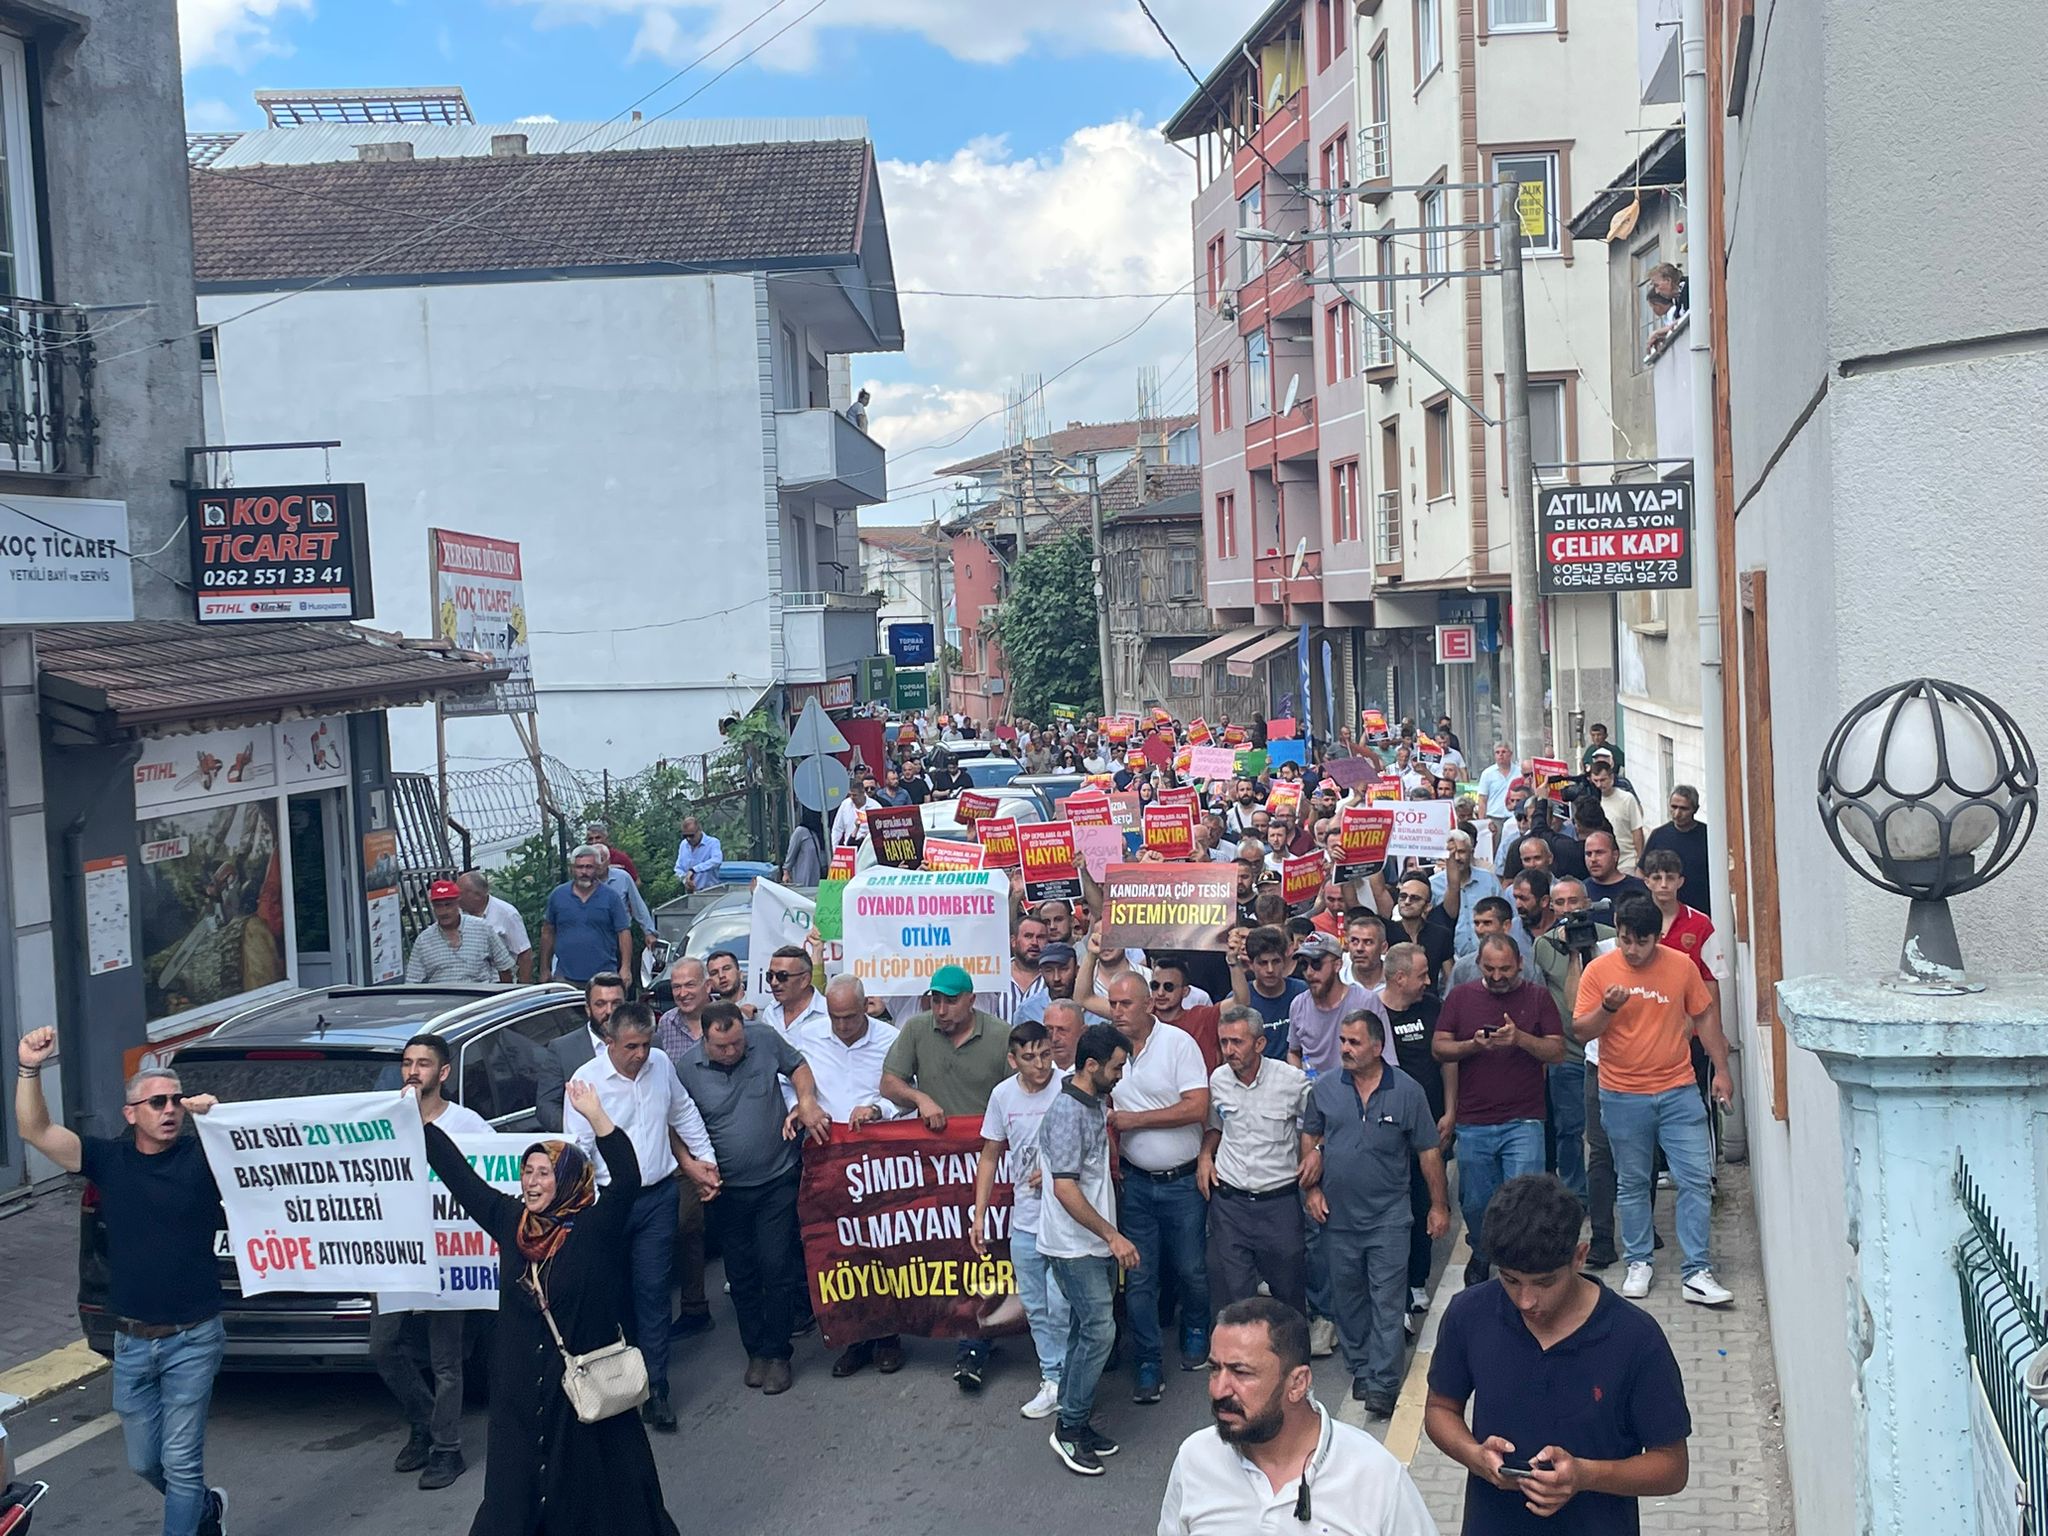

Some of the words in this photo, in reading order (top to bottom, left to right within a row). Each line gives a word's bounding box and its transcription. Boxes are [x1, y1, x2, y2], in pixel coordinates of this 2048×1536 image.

[233, 495, 303, 532] KOÇ
[1546, 491, 1623, 516] ATILIM
[1628, 489, 1683, 512] YAPI
[1554, 515, 1675, 531] DEKORASYON
[0, 535, 37, 563] KOÇ
[42, 532, 117, 558] TİCARET
[1622, 533, 1679, 556] KAPI
[203, 570, 249, 586] 0262
[254, 568, 287, 585] 551
[292, 567, 316, 584] 33
[320, 566, 343, 583] 41
[1562, 563, 1603, 576] 0543
[1606, 562, 1632, 573] 216
[1635, 560, 1653, 572] 47
[1658, 560, 1678, 571] 73
[1562, 574, 1602, 586] 0542
[1604, 573, 1634, 585] 564
[1636, 572, 1656, 583] 92
[1659, 570, 1678, 582] 70
[204, 603, 245, 614] STIHL
[136, 763, 177, 783] STIHL
[1113, 813, 1133, 825] SETÇİ
[1395, 808, 1428, 826] ÇÖP
[1148, 827, 1189, 845] HAYIR!
[1343, 830, 1386, 849] HAYIR!
[146, 842, 184, 860] STIHL
[883, 839, 918, 862] HAYIR!
[1025, 845, 1073, 867] HAYIR!
[935, 872, 990, 886] KOKUM
[1110, 883, 1173, 898] KANDIRA'DA
[1174, 881, 1195, 900] ÇÖP
[1198, 882, 1231, 898] TESİSİ
[857, 895, 915, 916] OYANDA
[918, 895, 995, 916] DOMBEYLE
[1110, 900, 1227, 926] İSTEMİYORUZ!
[902, 923, 951, 947] OTLİYA
[880, 953, 911, 983] ÇÖP
[1394, 1018, 1425, 1035] mavi
[229, 1126, 263, 1150] BİZ
[262, 1122, 303, 1149] SİZİ
[303, 1124, 330, 1146] 20
[329, 1119, 396, 1145] YILDIR
[234, 1160, 340, 1191] BAŞIMIZDA
[339, 1157, 414, 1187] TAŞIDIK
[845, 1151, 924, 1203] ŞİMDİ
[284, 1195, 315, 1223] SİZ
[316, 1192, 383, 1221] BİZLERİ
[837, 1205, 962, 1248] OLMAYAN
[247, 1229, 317, 1279] ÇÖPE
[318, 1240, 427, 1266] ATIYORSUNUZ
[818, 1256, 958, 1304] KÖYÜMÜZE
